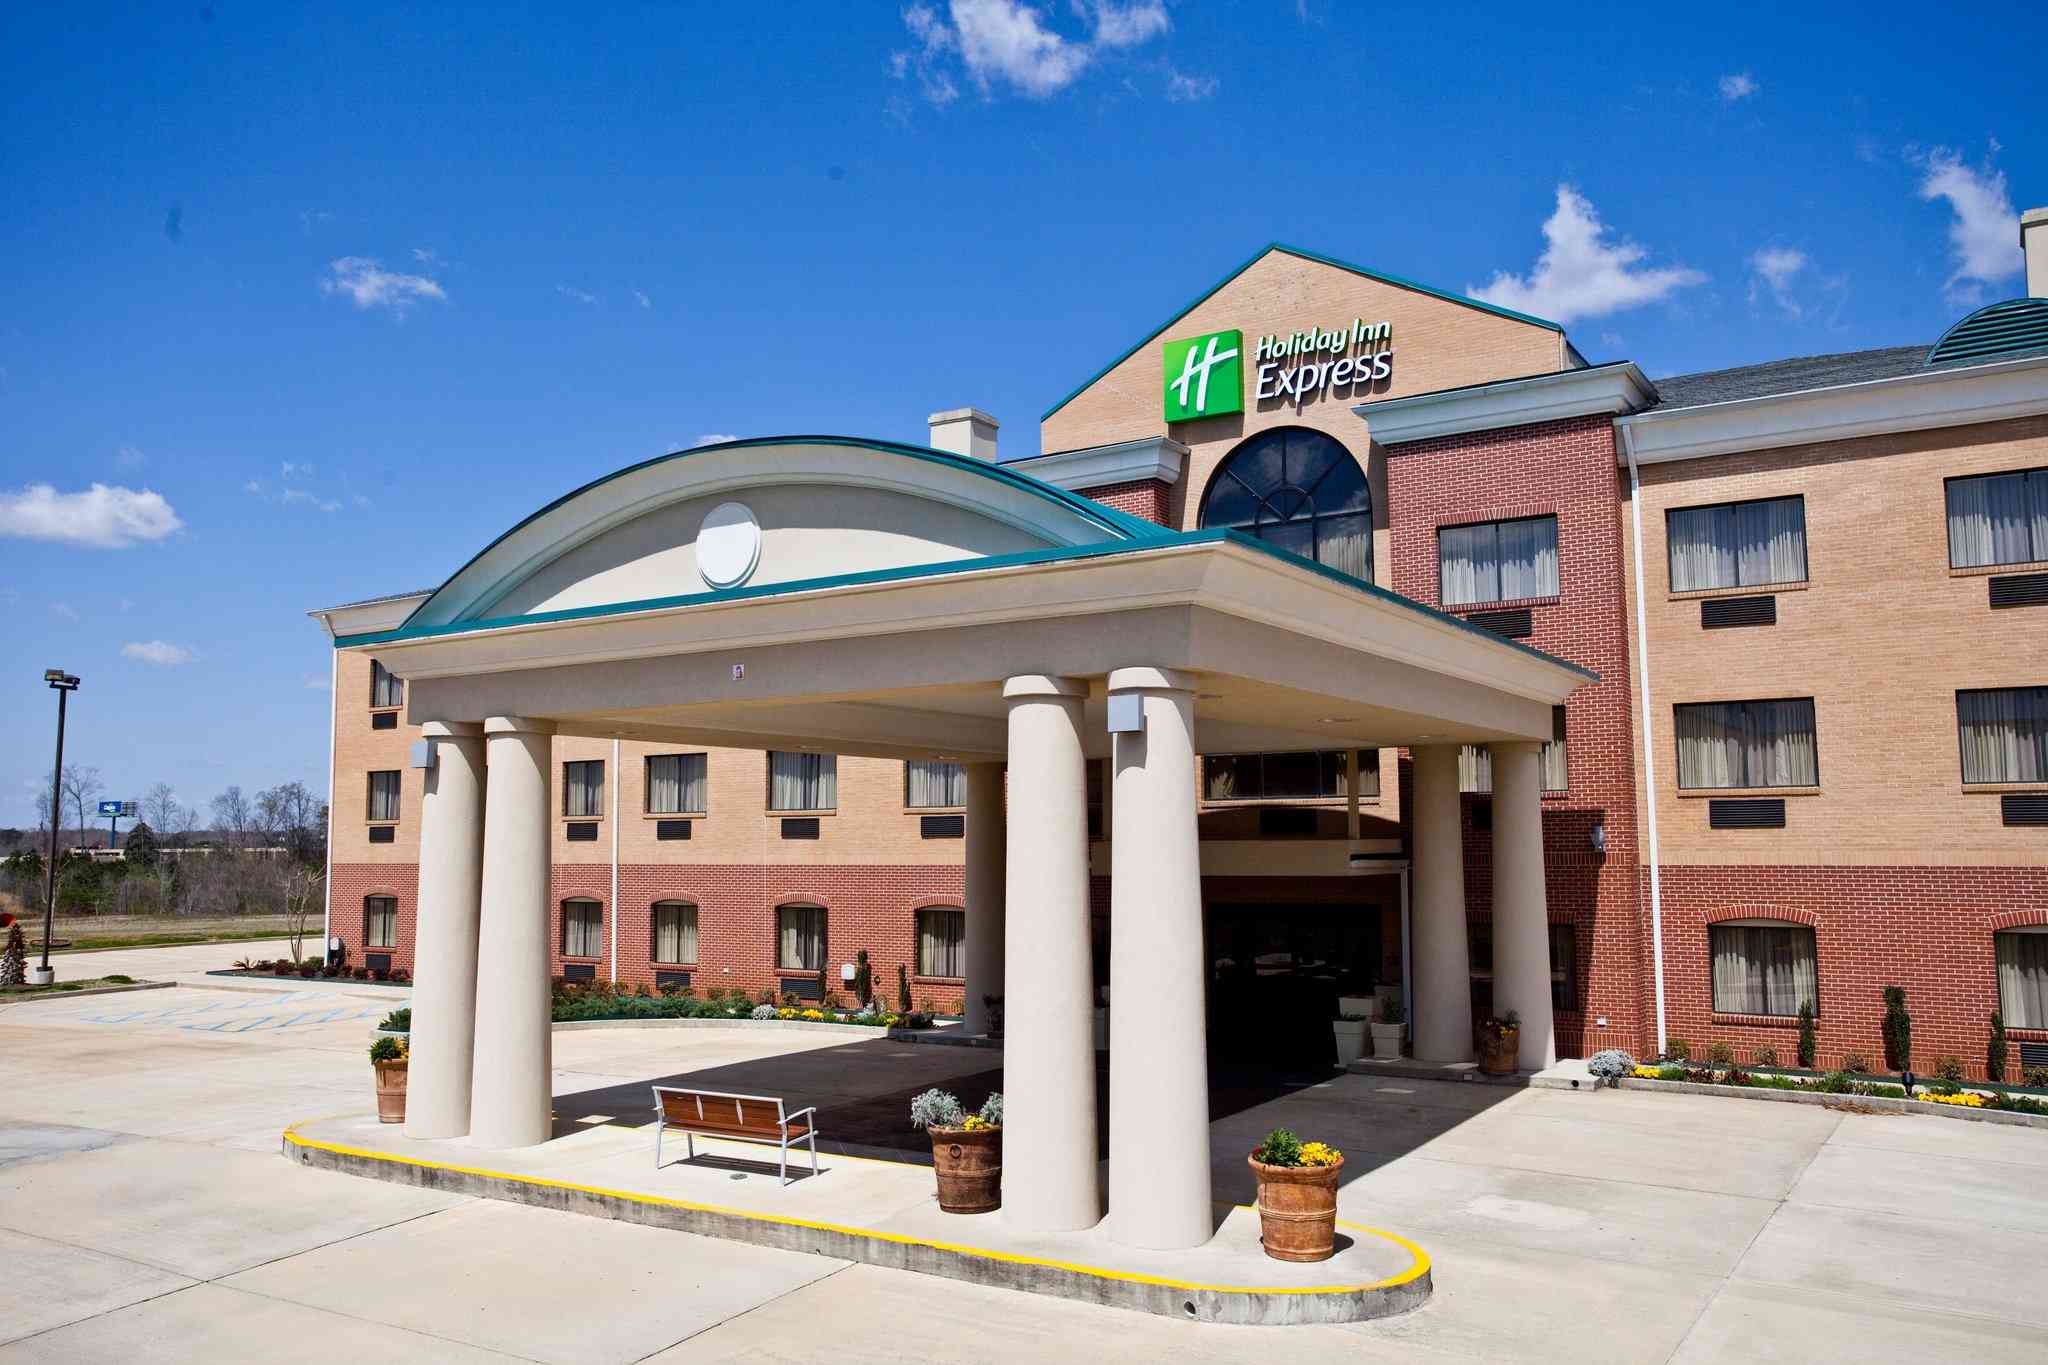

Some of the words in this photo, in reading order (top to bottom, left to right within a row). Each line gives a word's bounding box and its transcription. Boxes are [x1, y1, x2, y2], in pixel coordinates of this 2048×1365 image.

[1255, 326, 1348, 361] Holiday
[1351, 318, 1392, 344] Inn
[1255, 350, 1392, 403] Express
